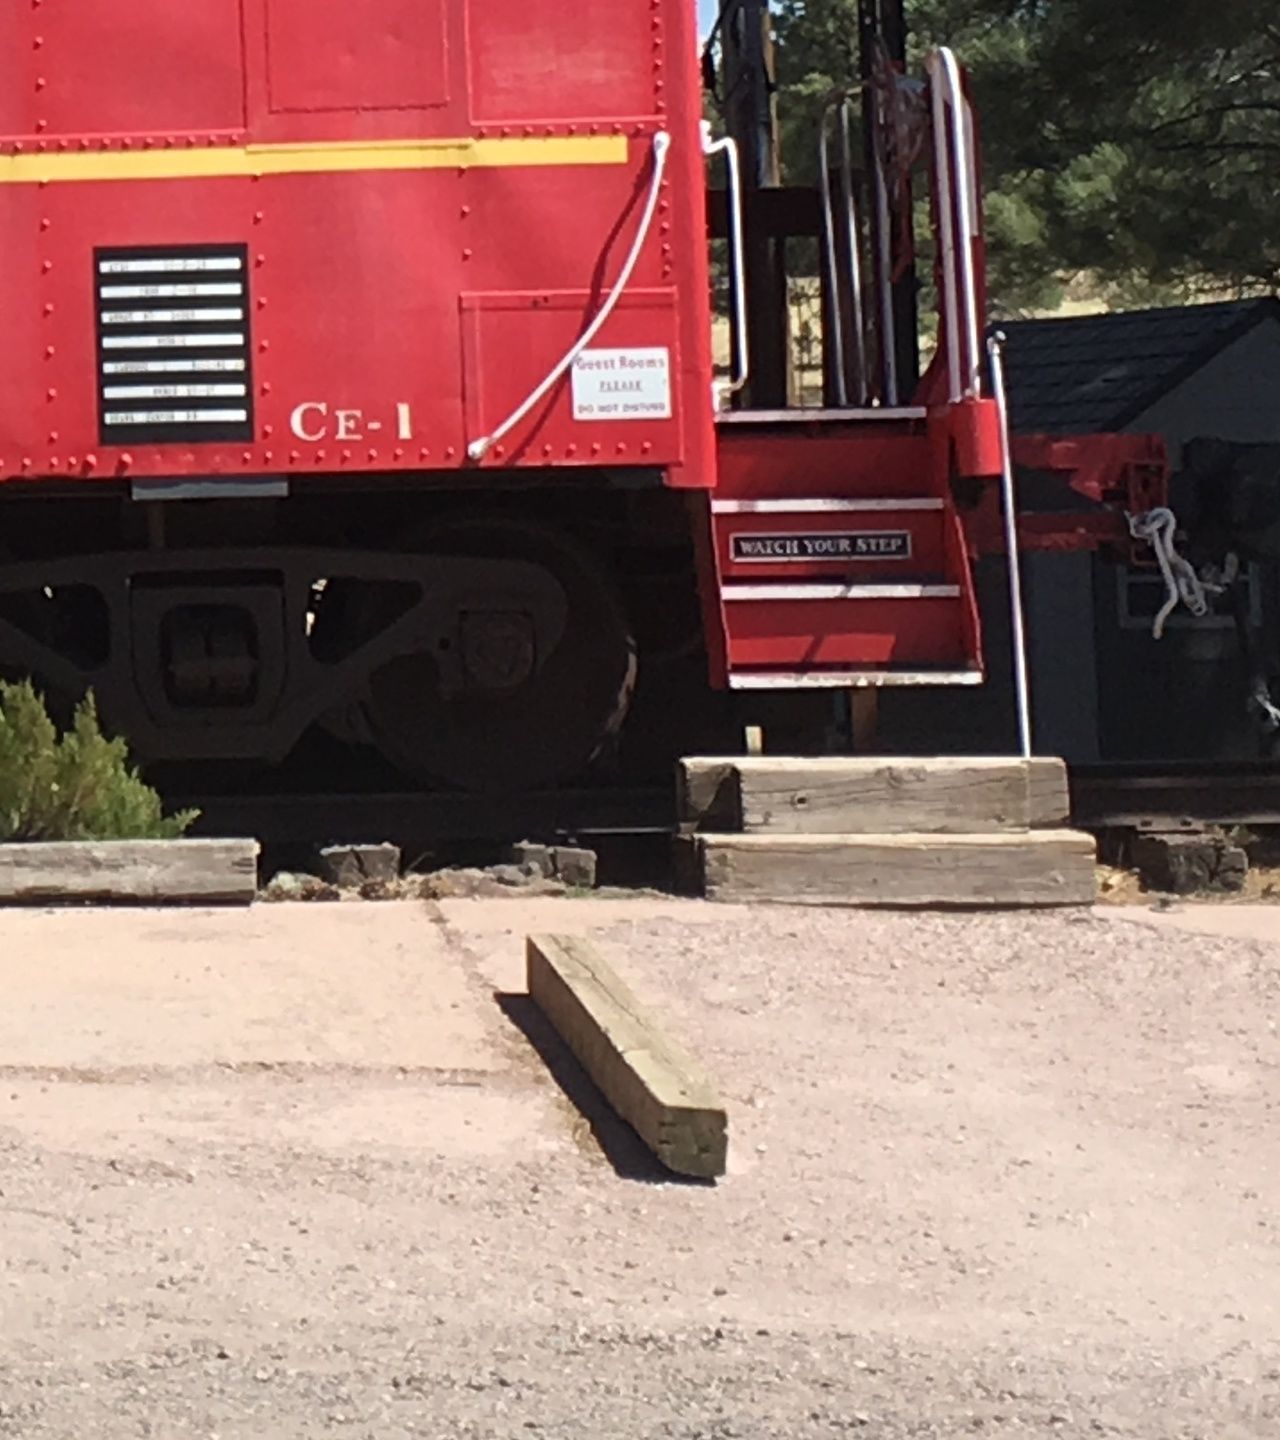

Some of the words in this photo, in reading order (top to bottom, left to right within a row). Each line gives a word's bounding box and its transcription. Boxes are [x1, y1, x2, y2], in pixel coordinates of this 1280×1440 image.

[739, 539, 799, 555] WATCH
[803, 538, 851, 553] YOUR
[855, 537, 903, 552] STEP
